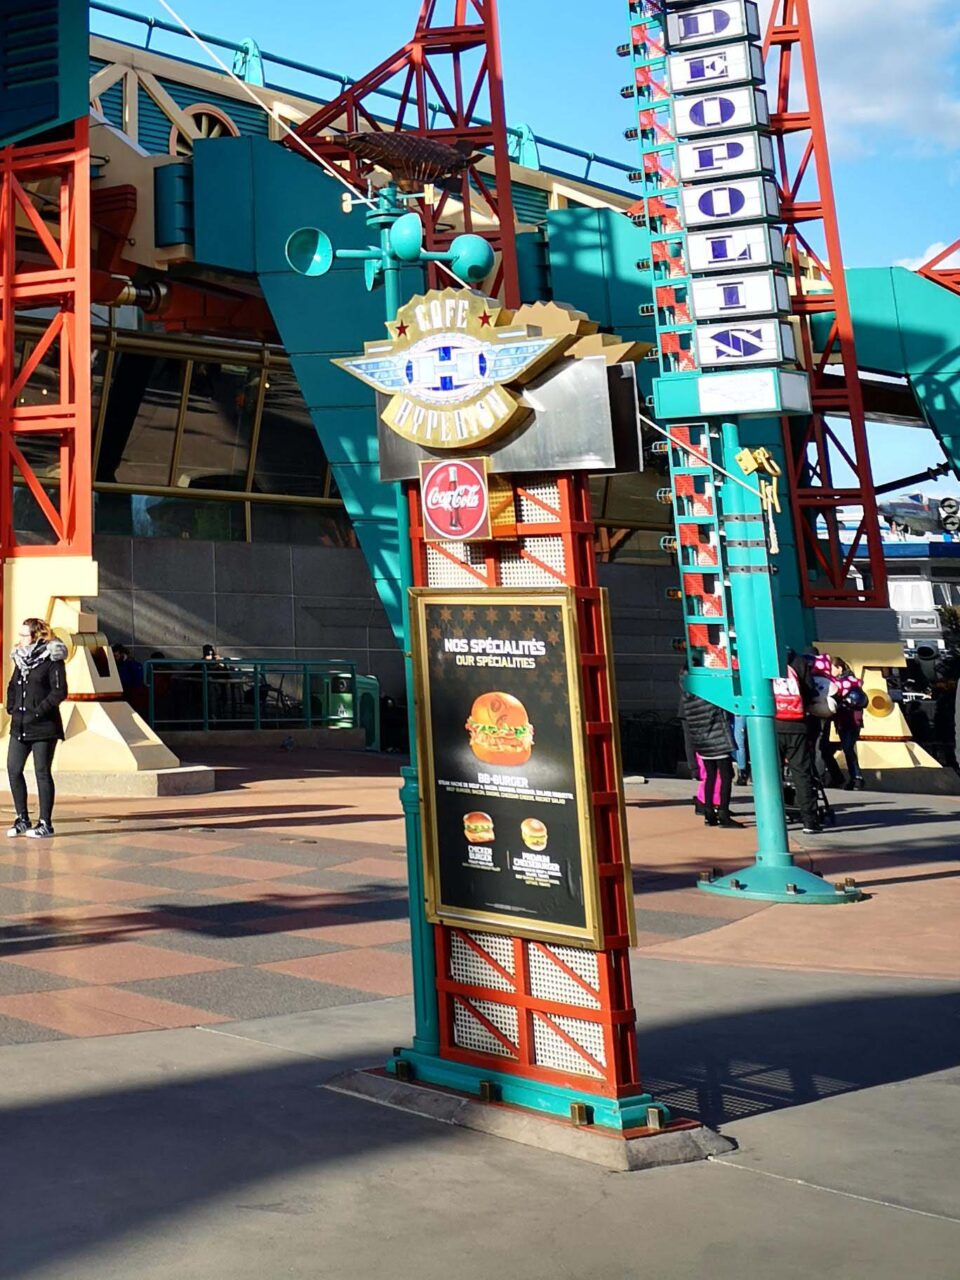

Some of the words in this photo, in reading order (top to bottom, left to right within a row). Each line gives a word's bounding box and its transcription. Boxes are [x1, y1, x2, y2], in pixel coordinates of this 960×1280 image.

[394, 389, 509, 441] HYPERION
[444, 638, 469, 652] NOS
[470, 637, 546, 655] SPÉCIALITÉS
[456, 655, 475, 665] OUR
